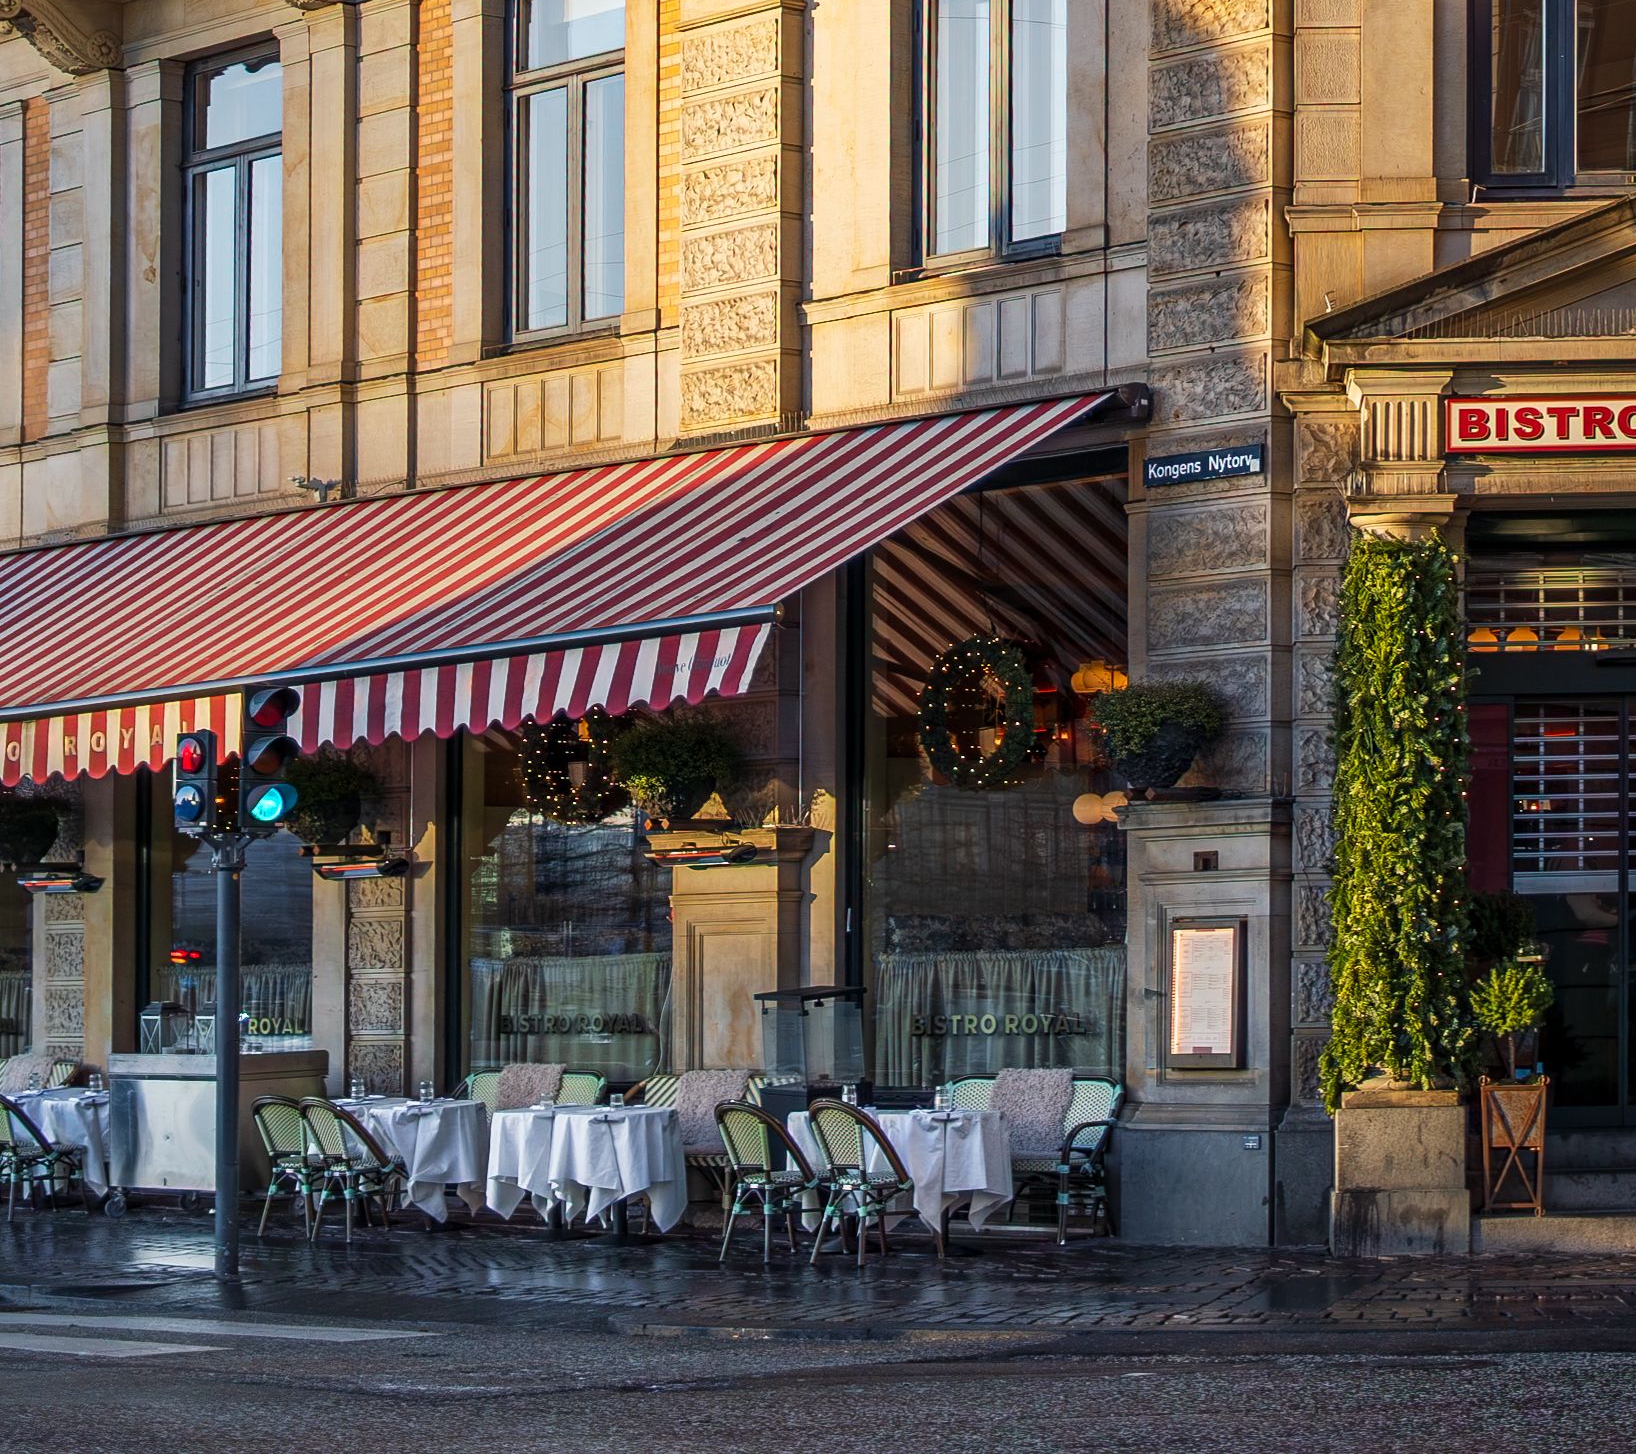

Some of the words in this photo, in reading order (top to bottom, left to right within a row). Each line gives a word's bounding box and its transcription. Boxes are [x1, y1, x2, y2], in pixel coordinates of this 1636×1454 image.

[1148, 461, 1202, 479] Kongens
[1208, 454, 1253, 473] Nytorv
[248, 1018, 304, 1035] ROYAL
[500, 1014, 572, 1034] BISTRO
[576, 1013, 644, 1034] ROYAL
[911, 1013, 998, 1035] BISTRO
[1004, 1011, 1086, 1035] ROYAL
